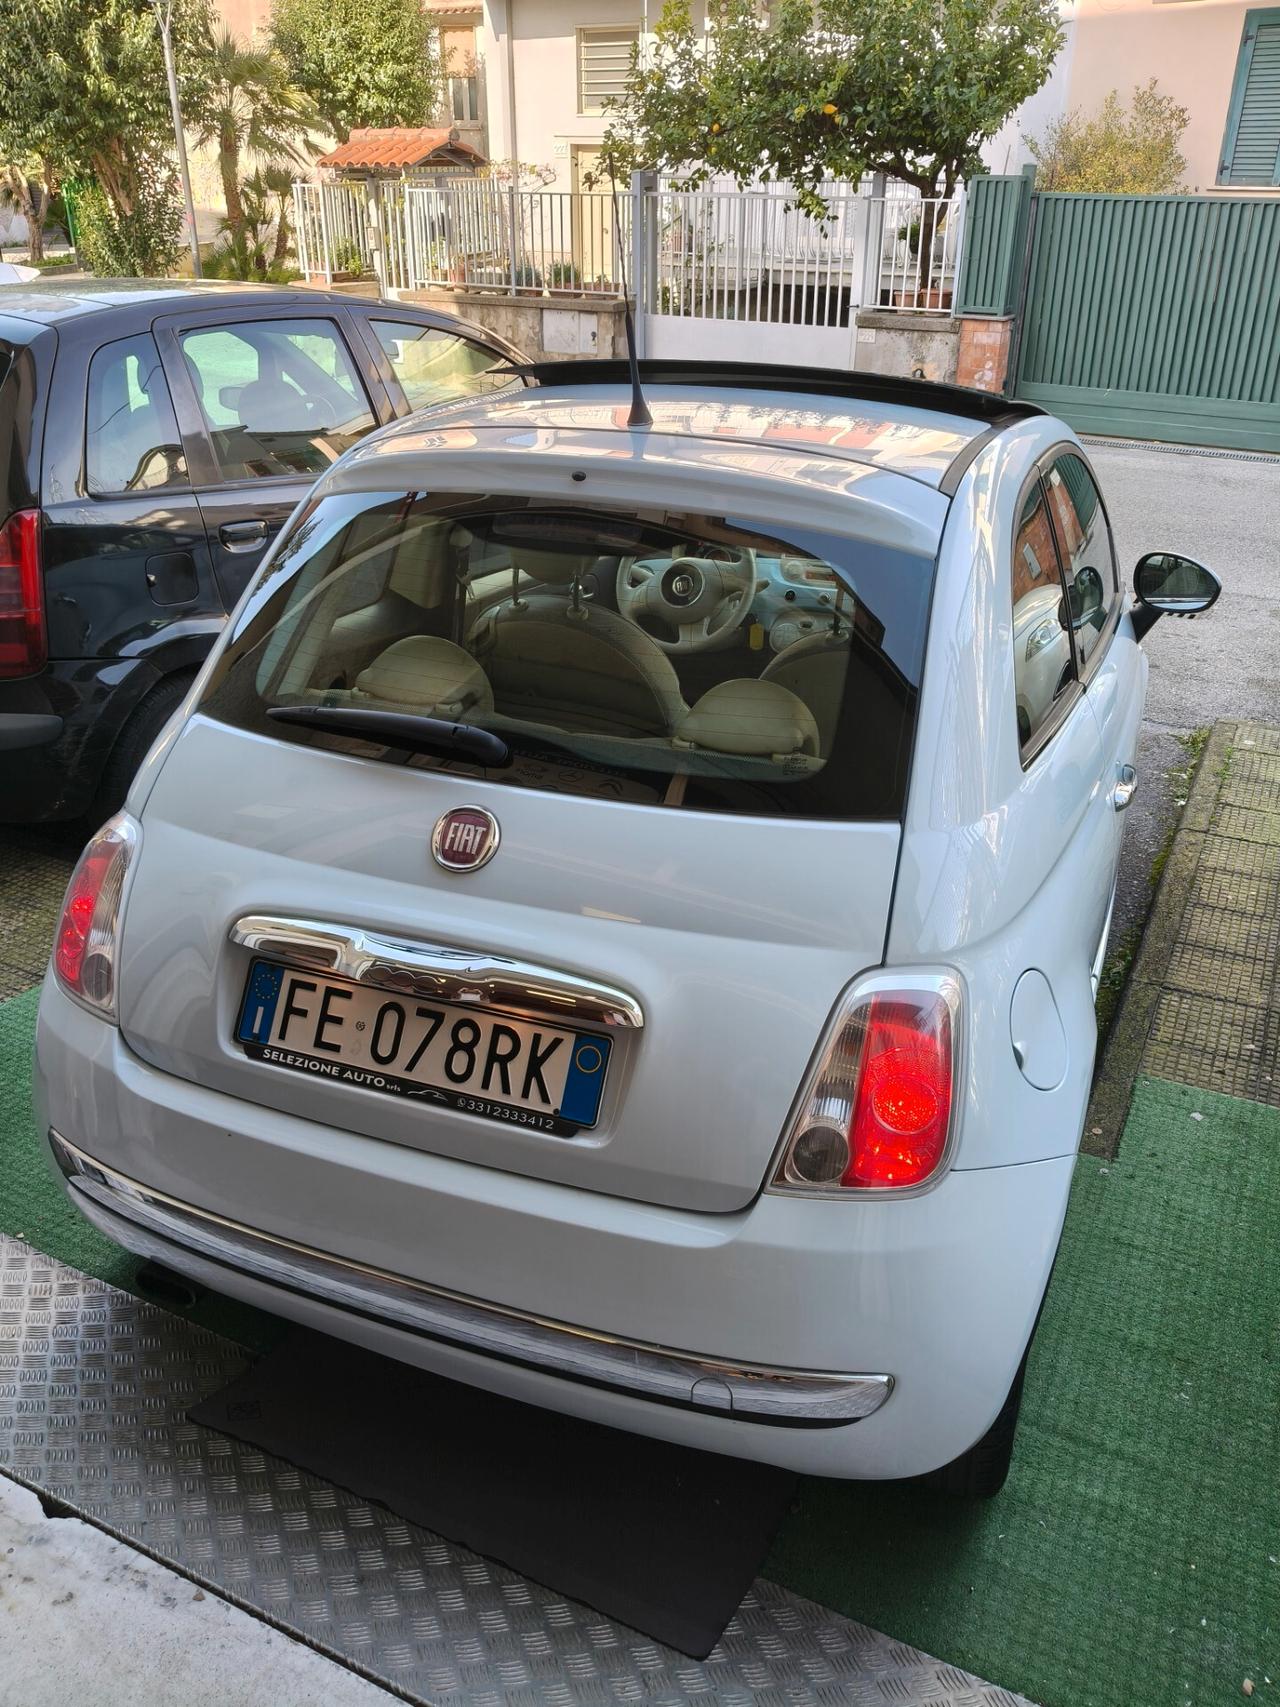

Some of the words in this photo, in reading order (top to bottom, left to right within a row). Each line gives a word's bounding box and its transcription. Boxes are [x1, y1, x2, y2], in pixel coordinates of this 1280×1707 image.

[444, 822, 487, 855] FIAT
[278, 978, 353, 1053] FE
[370, 1001, 564, 1105] 078RK
[263, 1048, 341, 1076] SELEZIONE
[343, 1070, 386, 1087] AUTO
[467, 1099, 555, 1130] 3312333412
